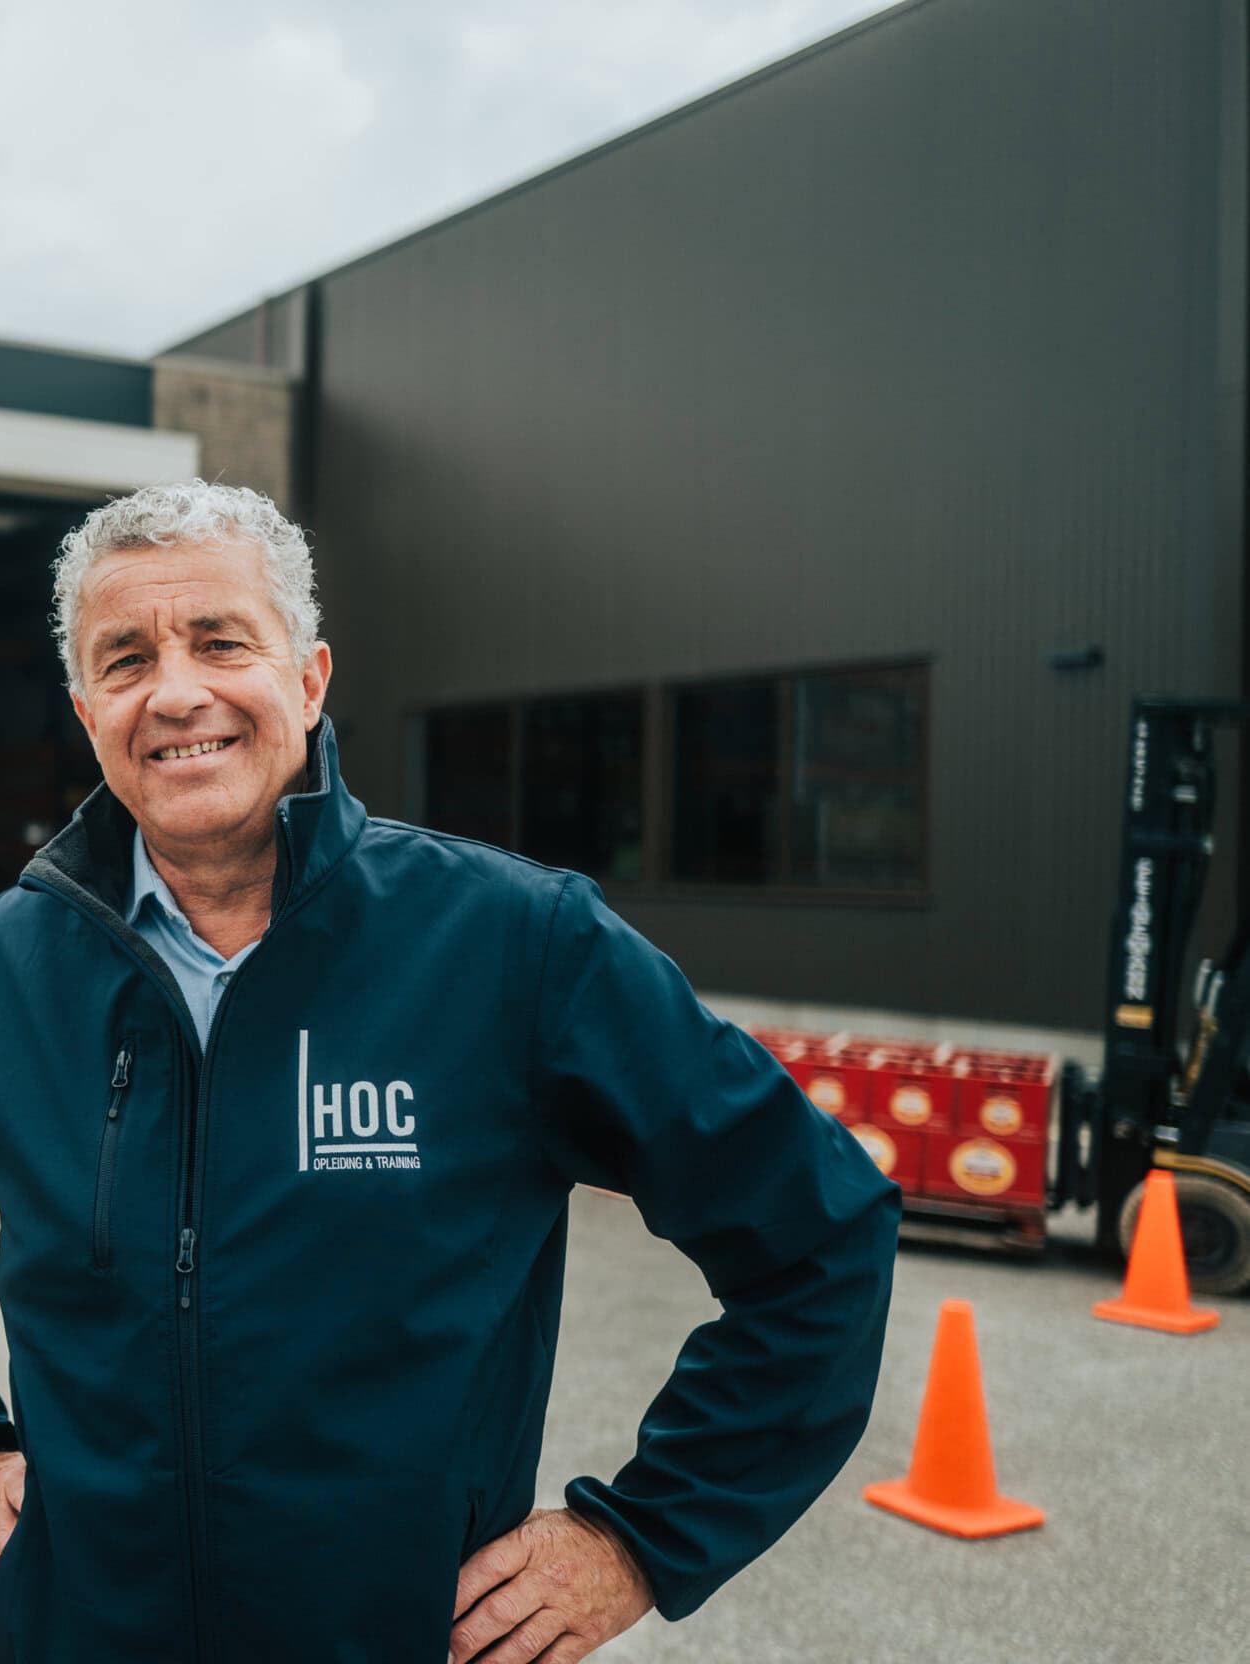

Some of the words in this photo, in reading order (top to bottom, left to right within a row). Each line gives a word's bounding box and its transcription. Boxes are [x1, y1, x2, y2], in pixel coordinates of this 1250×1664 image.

[313, 1080, 415, 1138] HOC
[313, 1156, 363, 1171] OPLEIDING
[365, 1156, 373, 1169] &
[375, 1155, 421, 1169] TRAINING
